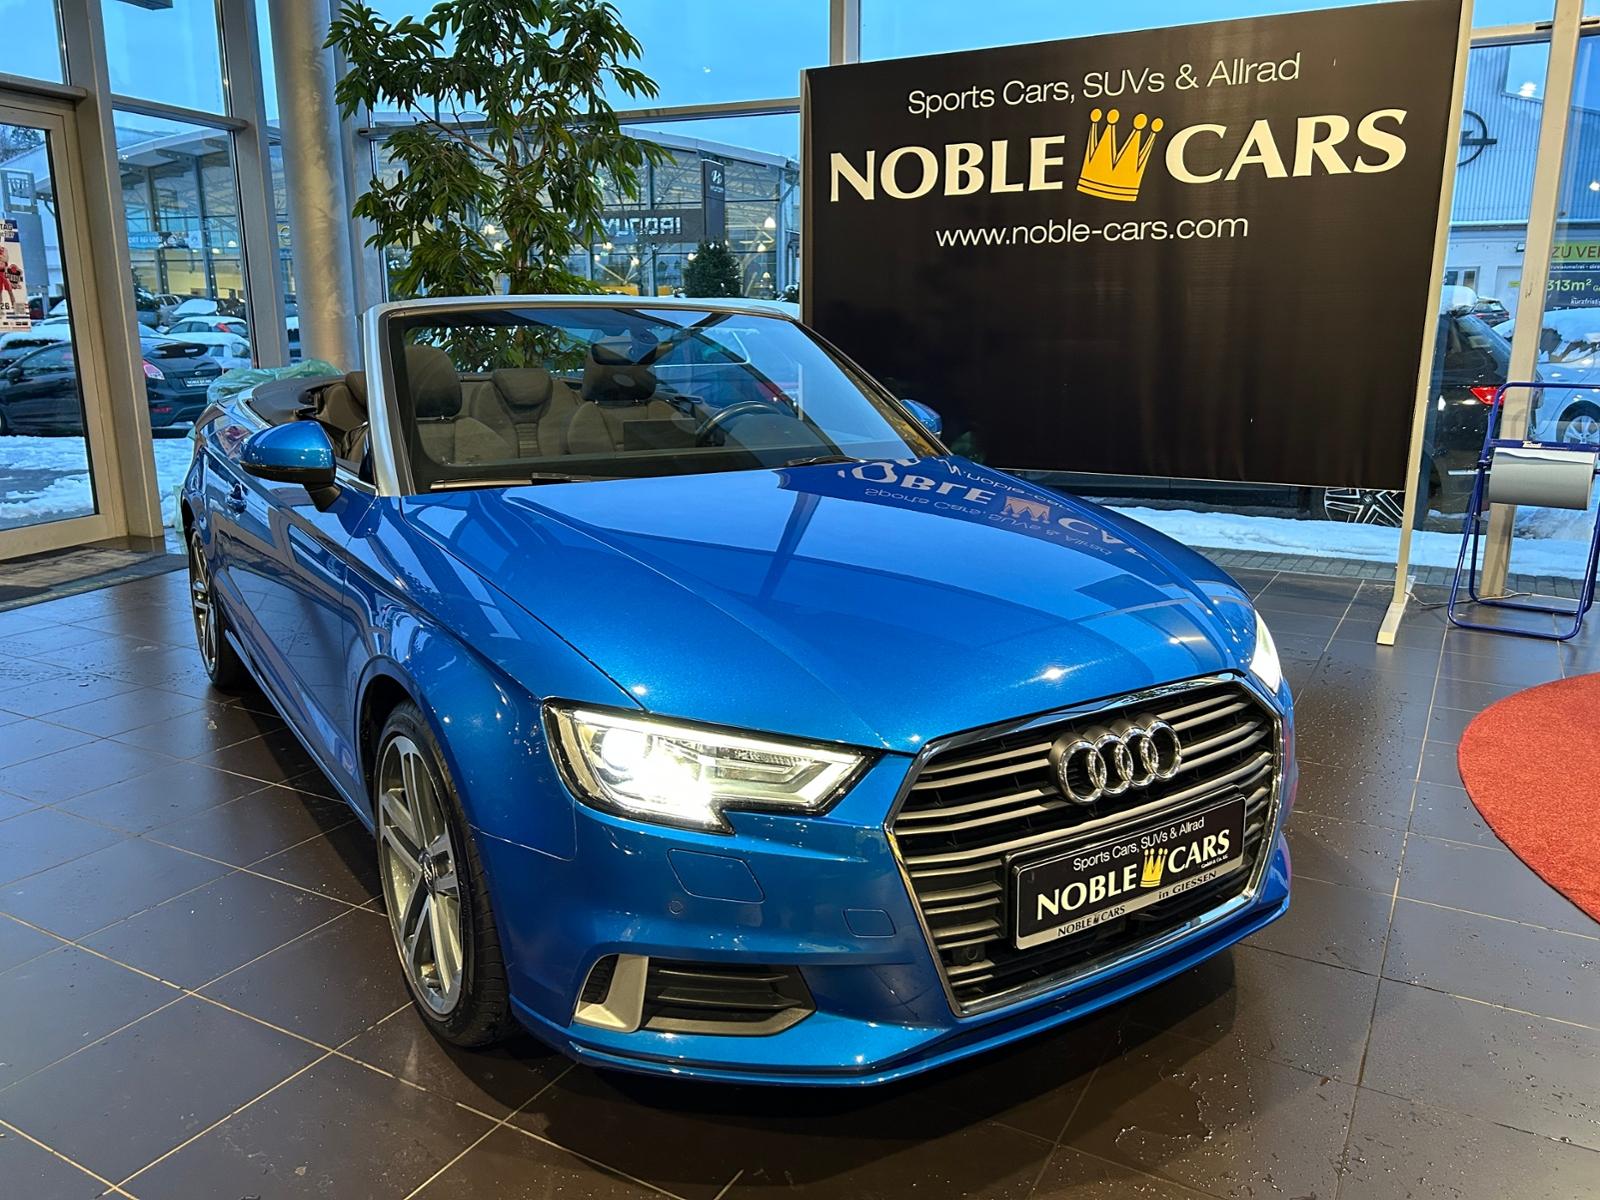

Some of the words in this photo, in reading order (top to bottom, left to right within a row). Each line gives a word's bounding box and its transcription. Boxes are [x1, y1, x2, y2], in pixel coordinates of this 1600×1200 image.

[908, 86, 995, 118] Sports
[1003, 81, 1075, 105] Cars,
[1082, 68, 1165, 98] SUVs
[1176, 63, 1199, 90] &
[1206, 52, 1301, 88] Allrad
[830, 136, 1066, 203] NOBLE
[1166, 109, 1408, 183] CARS
[584, 216, 681, 236] YUNDAI
[935, 218, 1249, 247] www.noble-cars.com
[1552, 246, 1572, 258] ZU
[1576, 245, 1600, 258] VE
[1073, 851, 1110, 871] Sports
[1112, 842, 1139, 859] Cars,
[1140, 831, 1169, 849] SUVs
[1169, 827, 1178, 839] &
[1179, 816, 1205, 836] Allrad
[1037, 864, 1138, 921] NOBLE
[1167, 829, 1230, 873] CARS
[1158, 891, 1169, 899] in
[1172, 871, 1217, 894] GIESSEN
[1057, 917, 1092, 936] NOBLE
[1100, 905, 1126, 921] CARS
